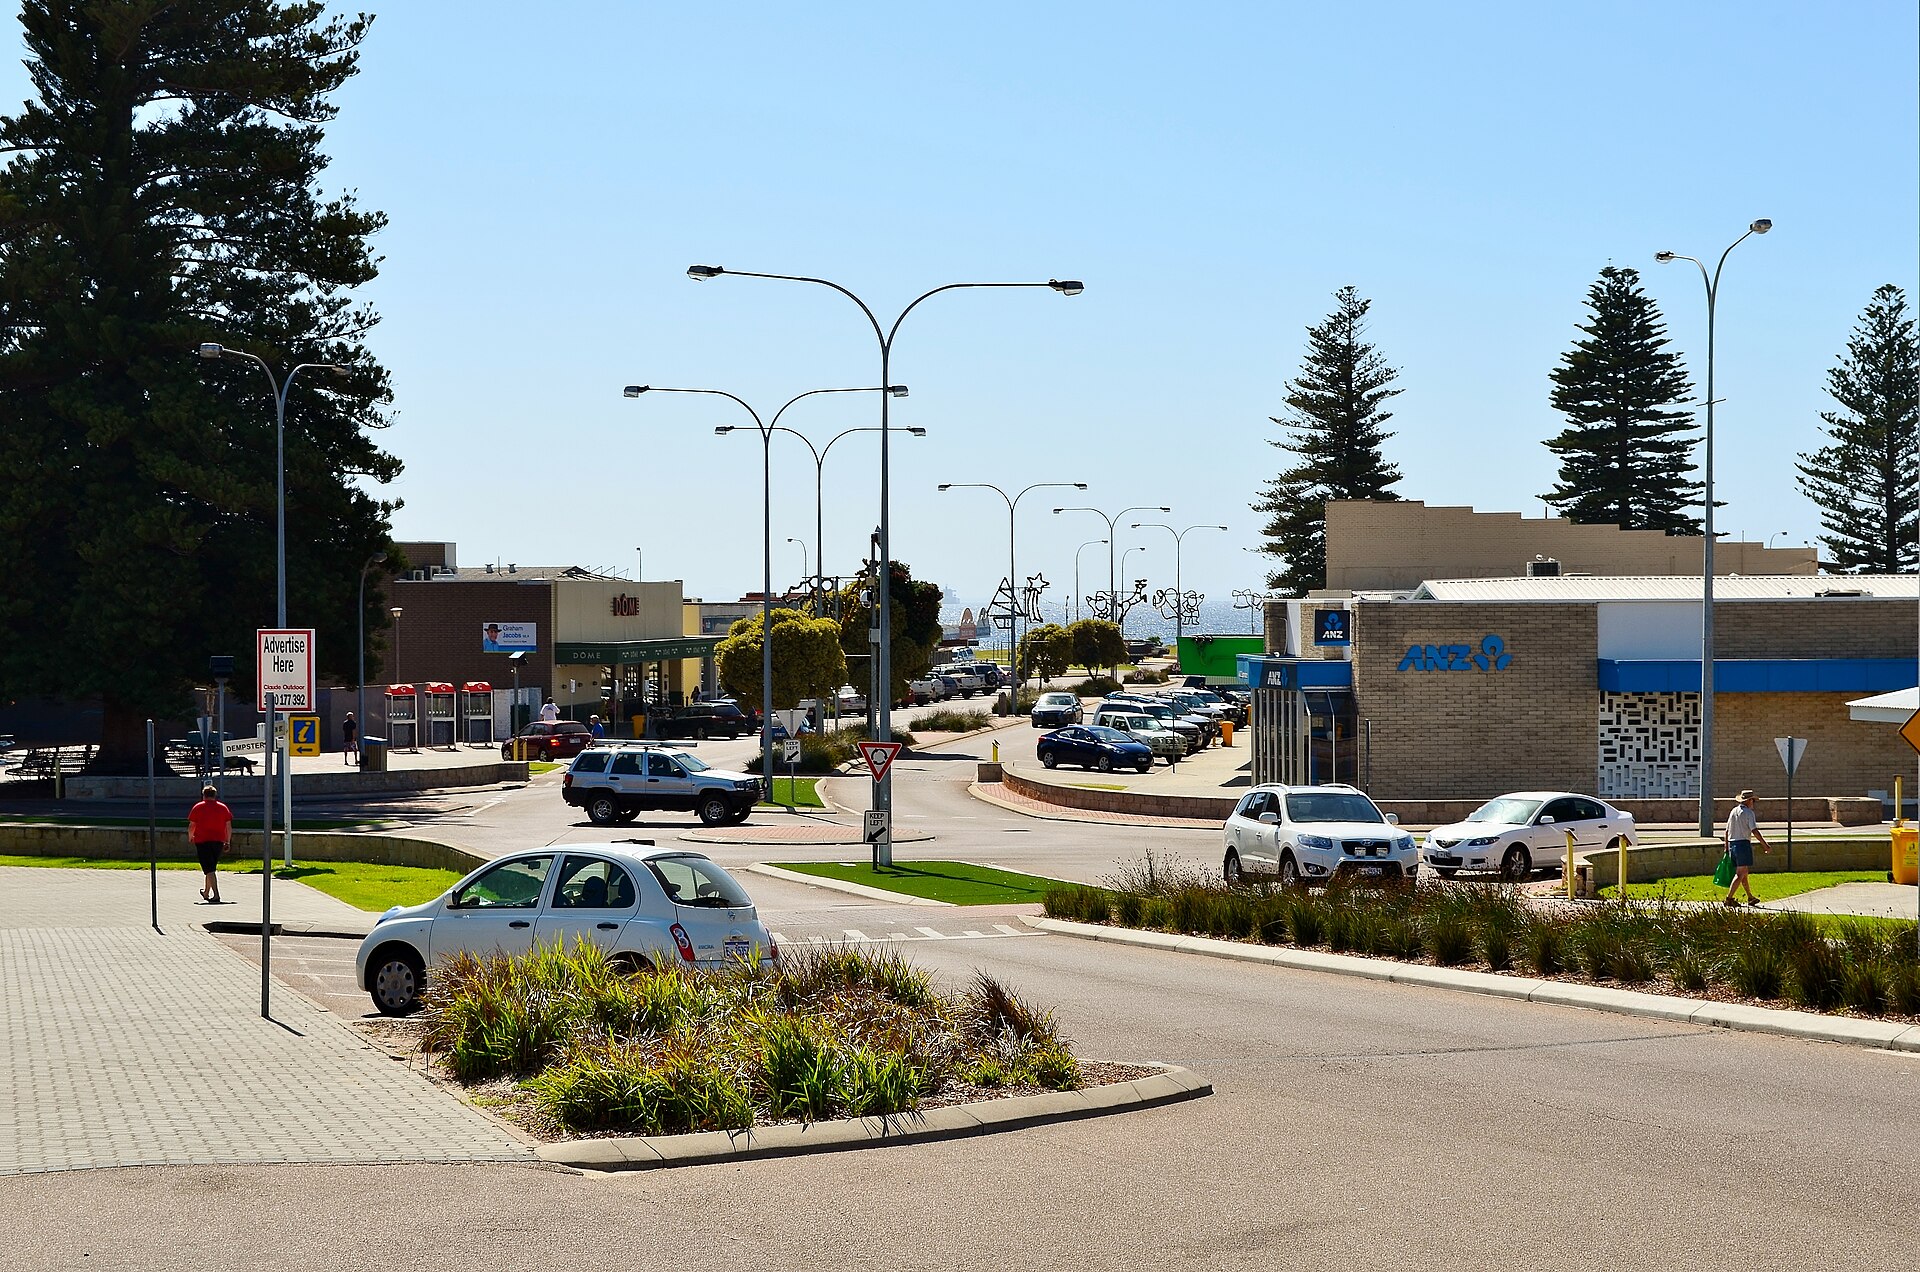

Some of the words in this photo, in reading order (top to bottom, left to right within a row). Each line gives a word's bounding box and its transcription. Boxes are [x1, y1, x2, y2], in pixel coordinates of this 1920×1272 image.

[1322, 630, 1343, 639] ANZ
[264, 636, 305, 654] Advertise
[273, 655, 294, 673] Here
[1397, 644, 1472, 671] ANZ
[1267, 670, 1282, 686] ANZ
[280, 694, 292, 706] 177
[292, 694, 306, 706] 392
[226, 741, 266, 752] DEMPSTER
